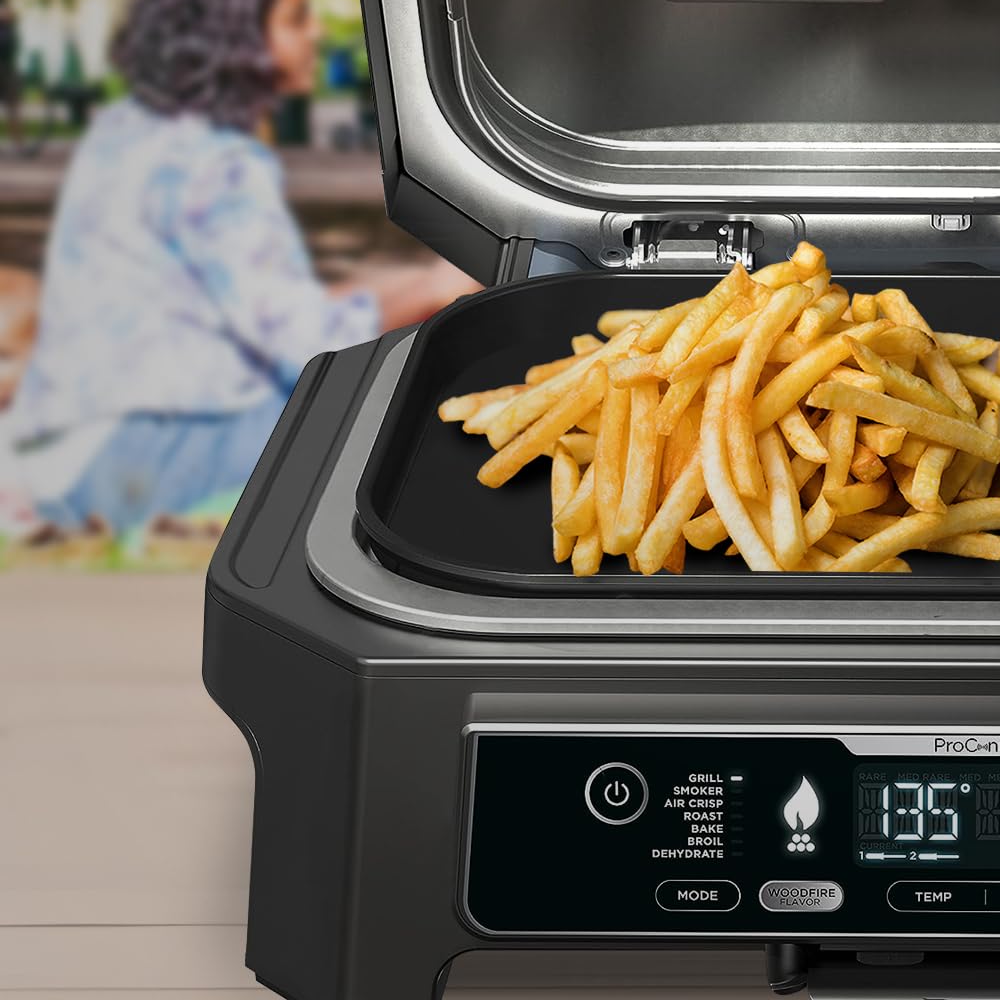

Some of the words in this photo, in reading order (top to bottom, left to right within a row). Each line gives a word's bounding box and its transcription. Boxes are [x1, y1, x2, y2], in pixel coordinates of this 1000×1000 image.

[688, 773, 724, 783] GRILL
[673, 786, 724, 796] SMOKER
[664, 799, 684, 809] AIR
[688, 799, 724, 809] CRISP
[683, 811, 724, 821] ROAST
[691, 824, 724, 834] BAKE
[687, 836, 724, 846] BROIL
[652, 849, 724, 859] DEHYDRATE
[909, 851, 917, 861] 2
[677, 890, 719, 901] MODE
[768, 888, 836, 898] WOODFIRE
[915, 891, 952, 902] TEMP
[779, 898, 821, 906] FLAVOR
